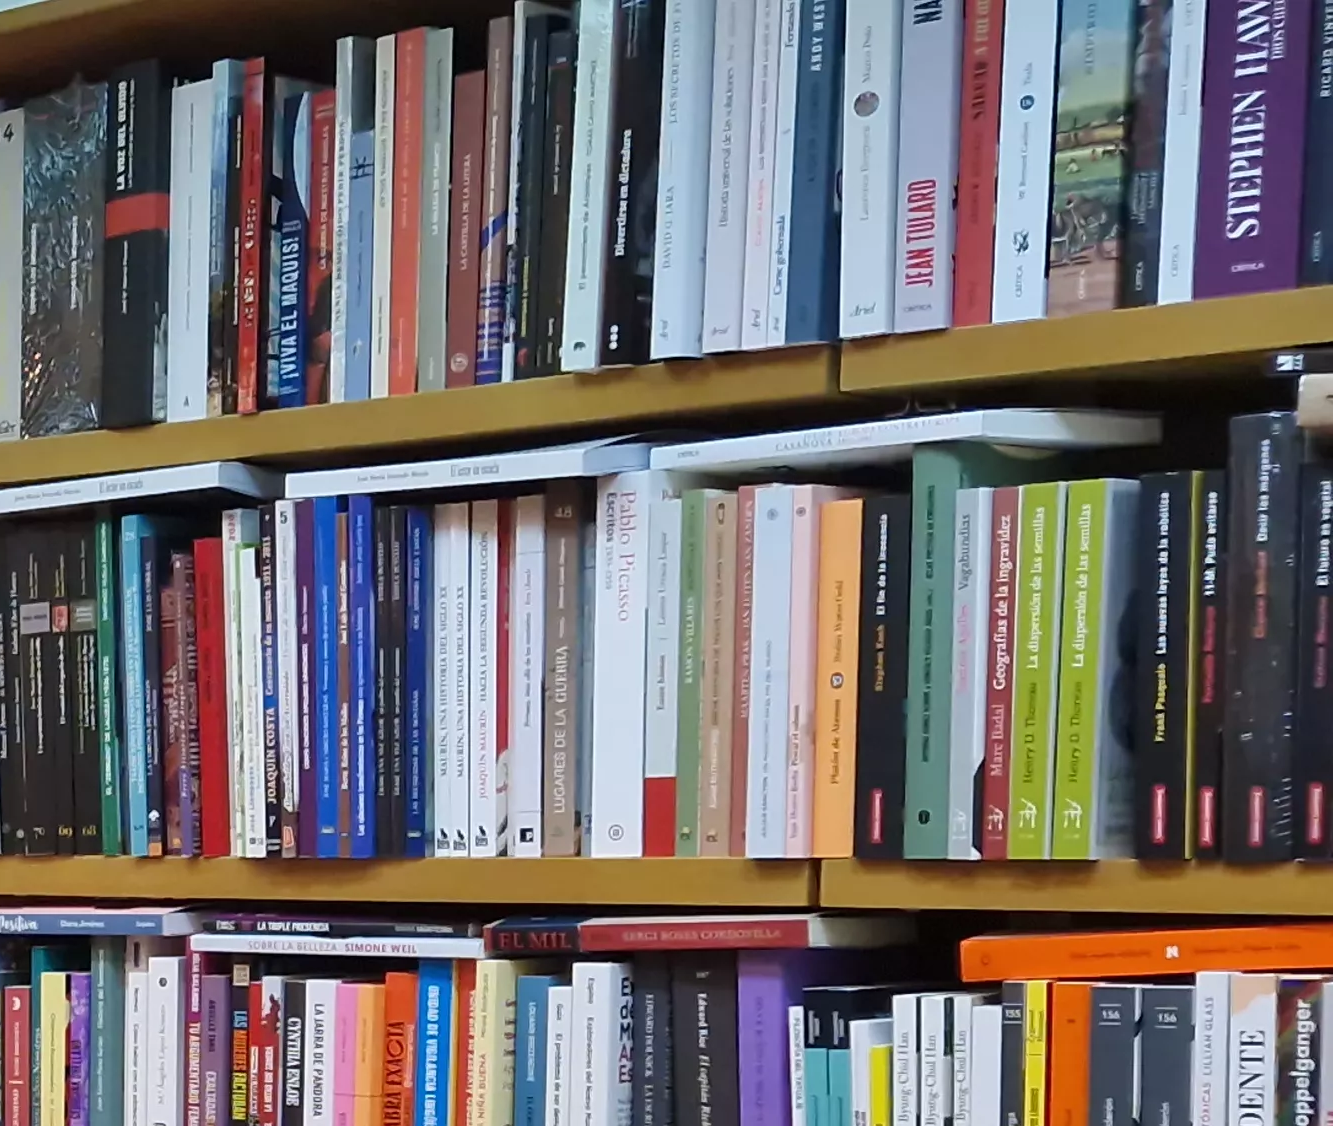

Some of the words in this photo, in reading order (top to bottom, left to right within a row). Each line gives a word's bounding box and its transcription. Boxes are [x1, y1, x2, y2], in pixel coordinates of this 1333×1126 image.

[1225, 89, 1267, 240] STEPHEN
[905, 178, 937, 244] TULARD
[281, 237, 300, 303] MAQUIS!
[904, 247, 935, 288] JEAN
[281, 309, 298, 334] EL
[606, 492, 618, 544] Escritos
[619, 491, 637, 546] Pablo
[1079, 503, 1092, 552] semillas
[998, 514, 1012, 577] ingravidez
[617, 552, 636, 622] Picasso
[1076, 573, 1088, 591] de
[997, 600, 1008, 618] de
[554, 645, 568, 703] GUERRA
[1072, 654, 1084, 668] La
[554, 708, 566, 723] LA
[991, 703, 1005, 736] Badal
[554, 724, 566, 747] DE
[990, 739, 1004, 777] Marc
[554, 750, 567, 814] LUGARES
[344, 943, 389, 954] SIMONE
[390, 943, 418, 955] WEIL
[498, 932, 524, 948] EL
[529, 931, 572, 948] MIL
[313, 1003, 325, 1016] LA
[313, 1017, 325, 1049] JARRA
[313, 1051, 325, 1067] DE
[312, 1068, 325, 1118] PANDORA
